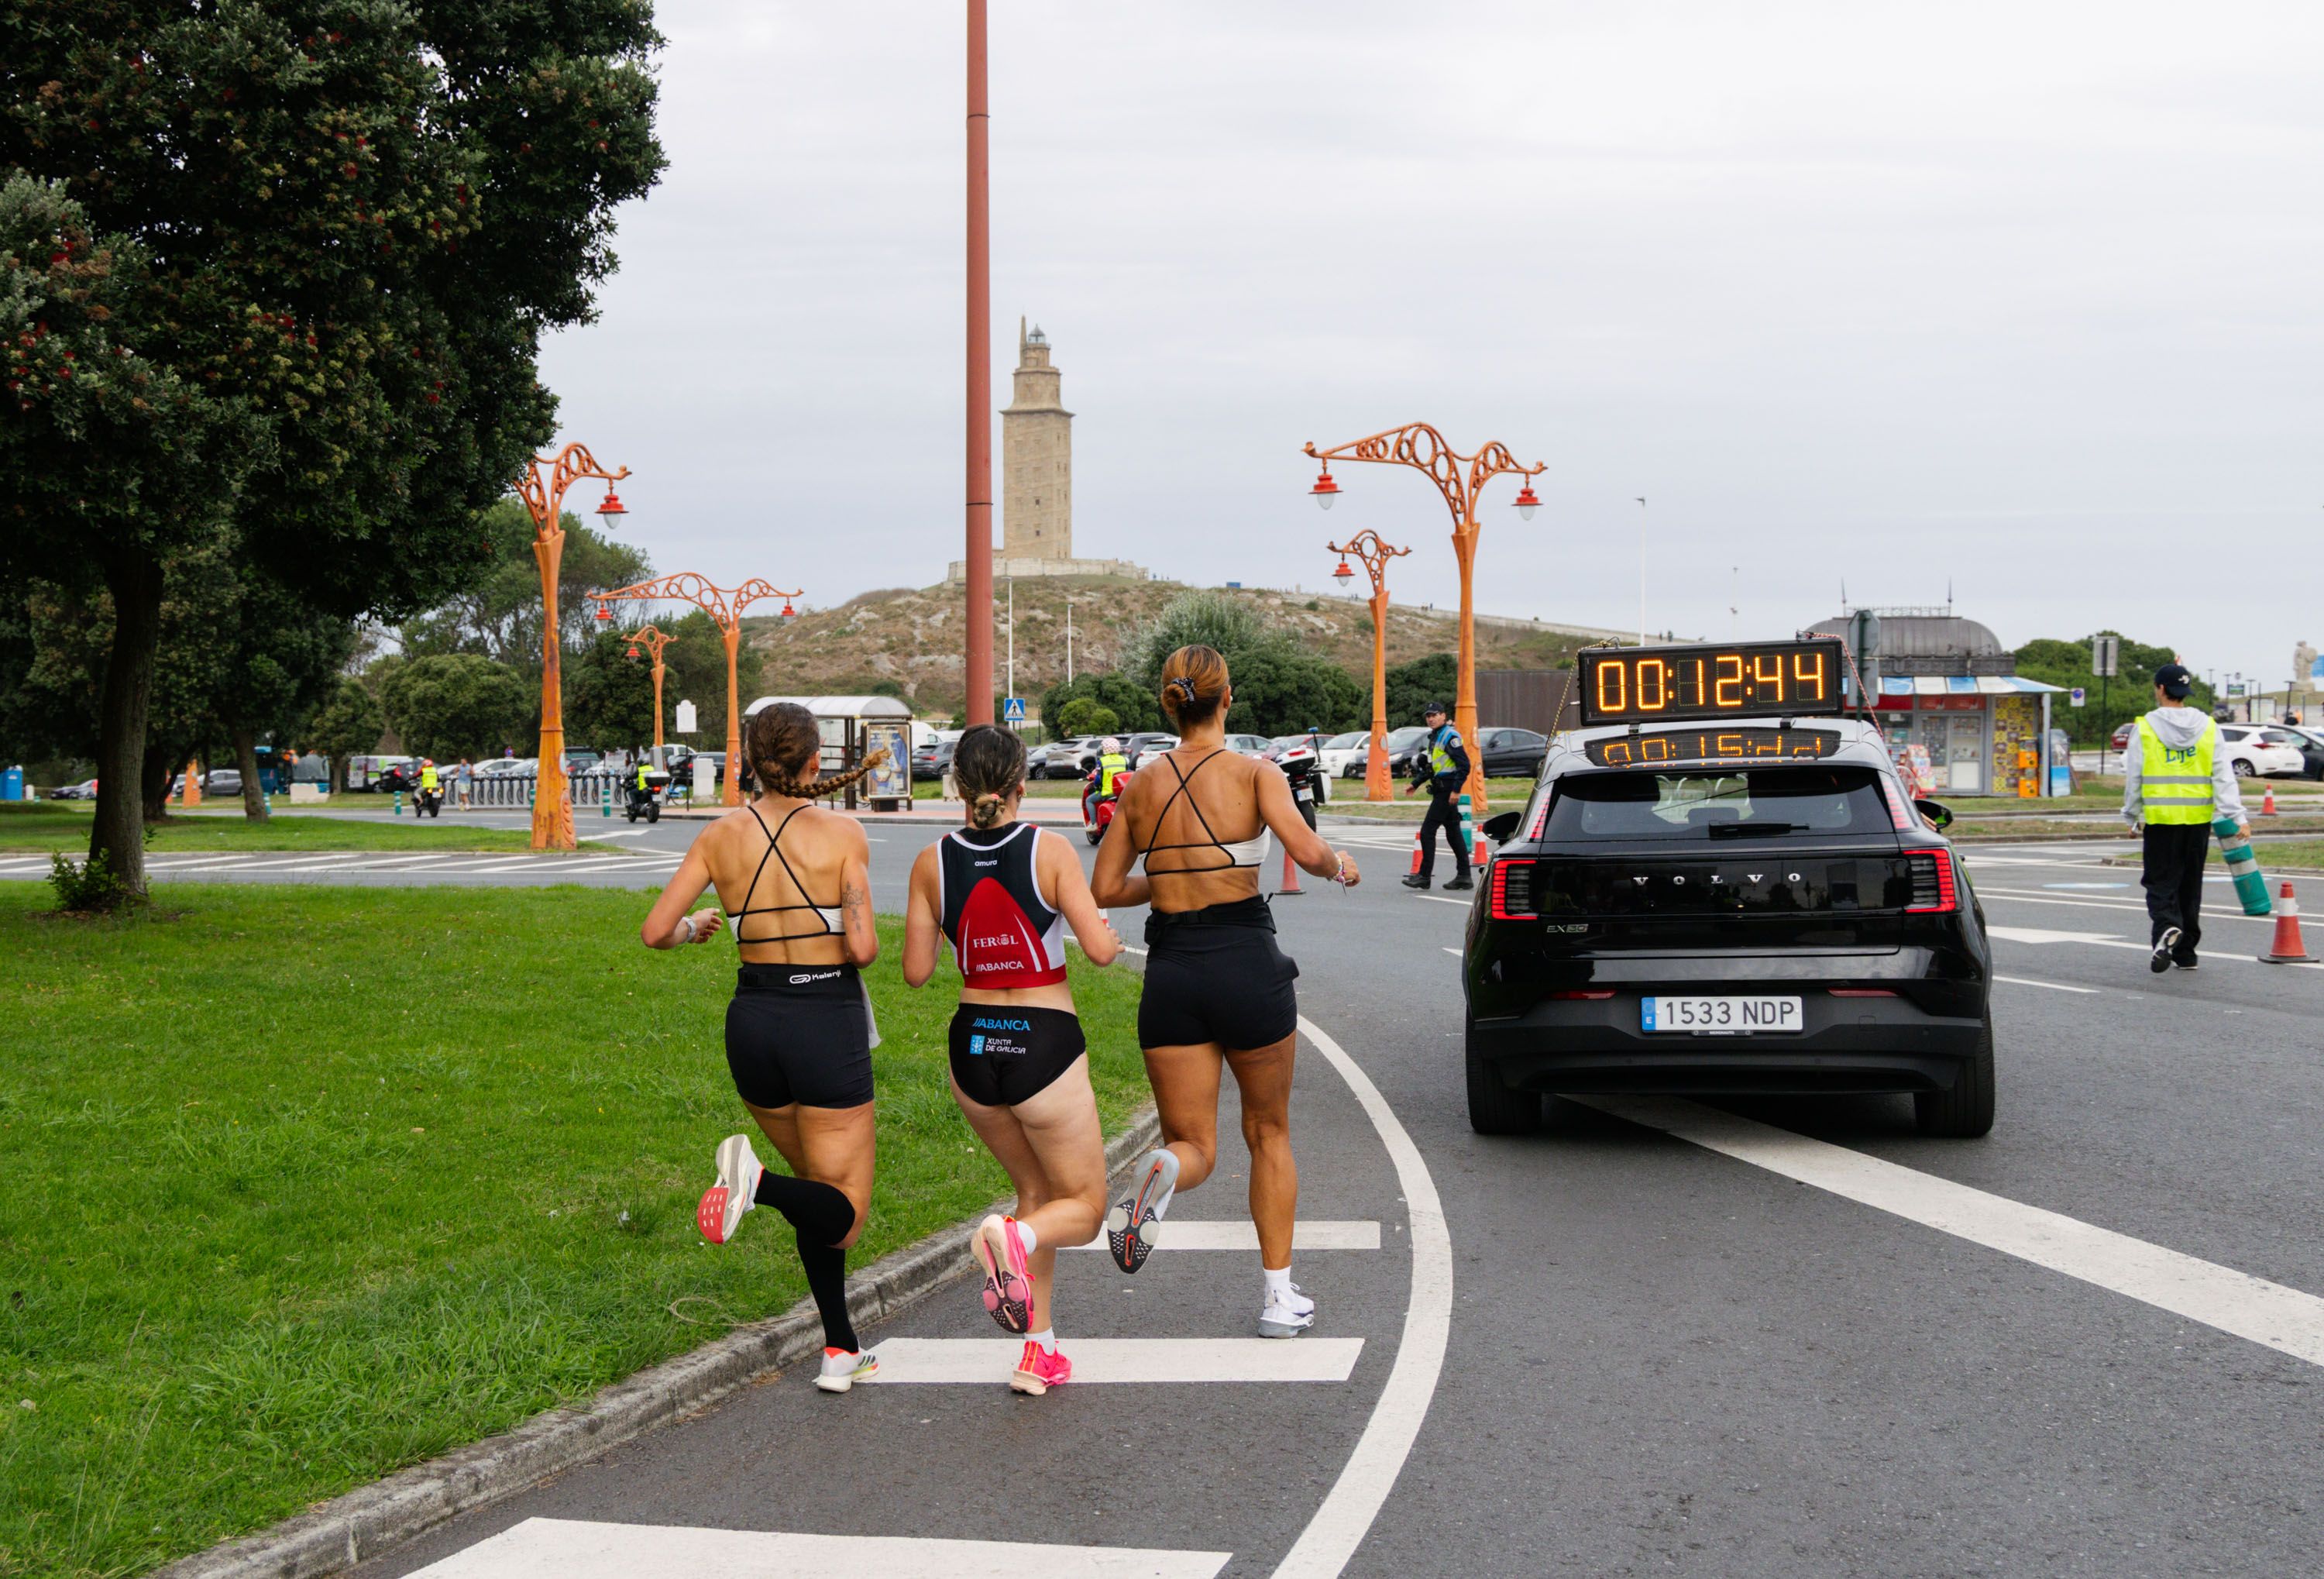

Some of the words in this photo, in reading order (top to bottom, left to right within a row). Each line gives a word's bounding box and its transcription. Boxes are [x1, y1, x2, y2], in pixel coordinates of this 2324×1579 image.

[1598, 653, 1824, 711] 00:12:44
[1633, 873, 1801, 886] VOLVO
[812, 969, 841, 980] Kalenji
[1666, 1001, 1731, 1024] 1533
[1742, 1001, 1794, 1024] NDP
[987, 1037, 1012, 1046] XUNTA
